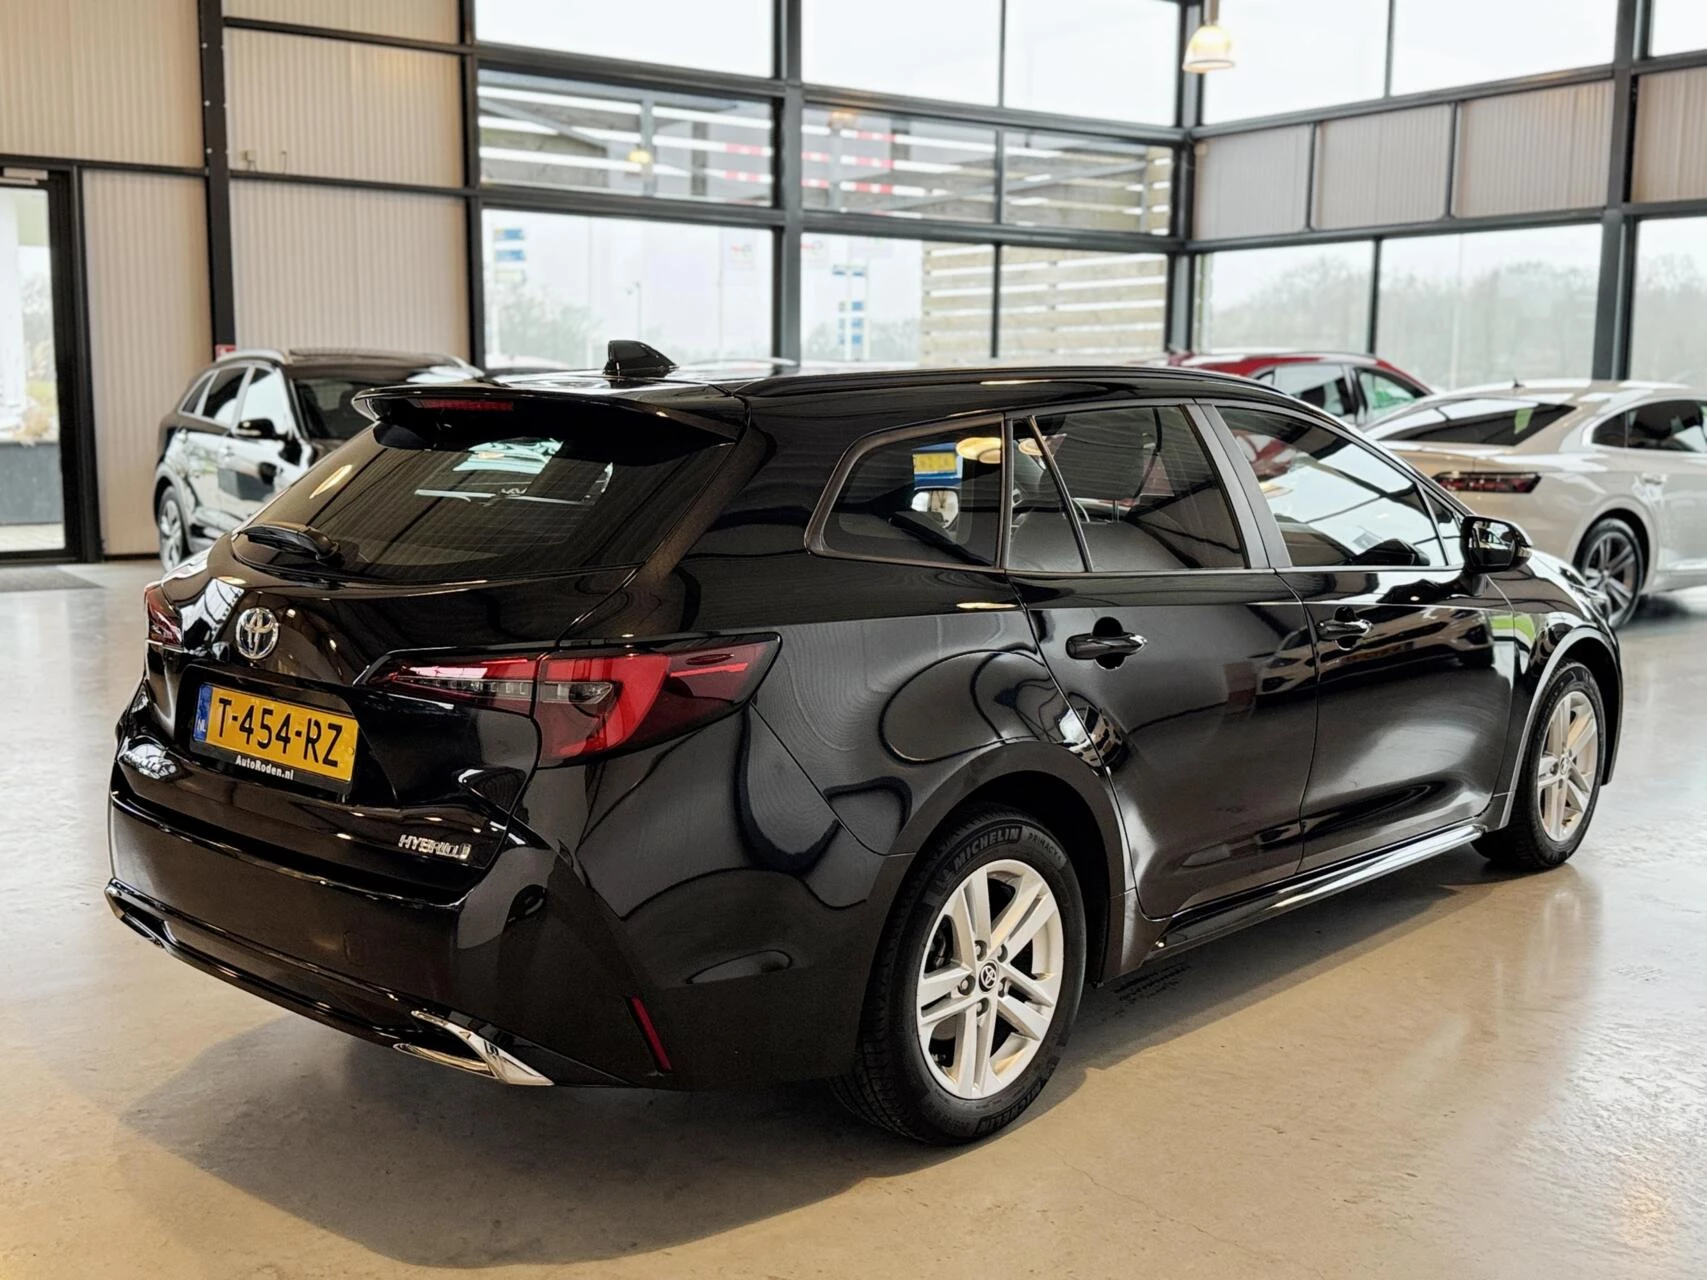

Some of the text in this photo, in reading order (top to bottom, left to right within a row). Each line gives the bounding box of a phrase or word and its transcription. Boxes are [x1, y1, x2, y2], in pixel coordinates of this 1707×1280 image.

[219, 698, 343, 768] T-454-RZ
[235, 755, 294, 780] AutoRoden.nl
[954, 827, 1020, 870] MICHELIN
